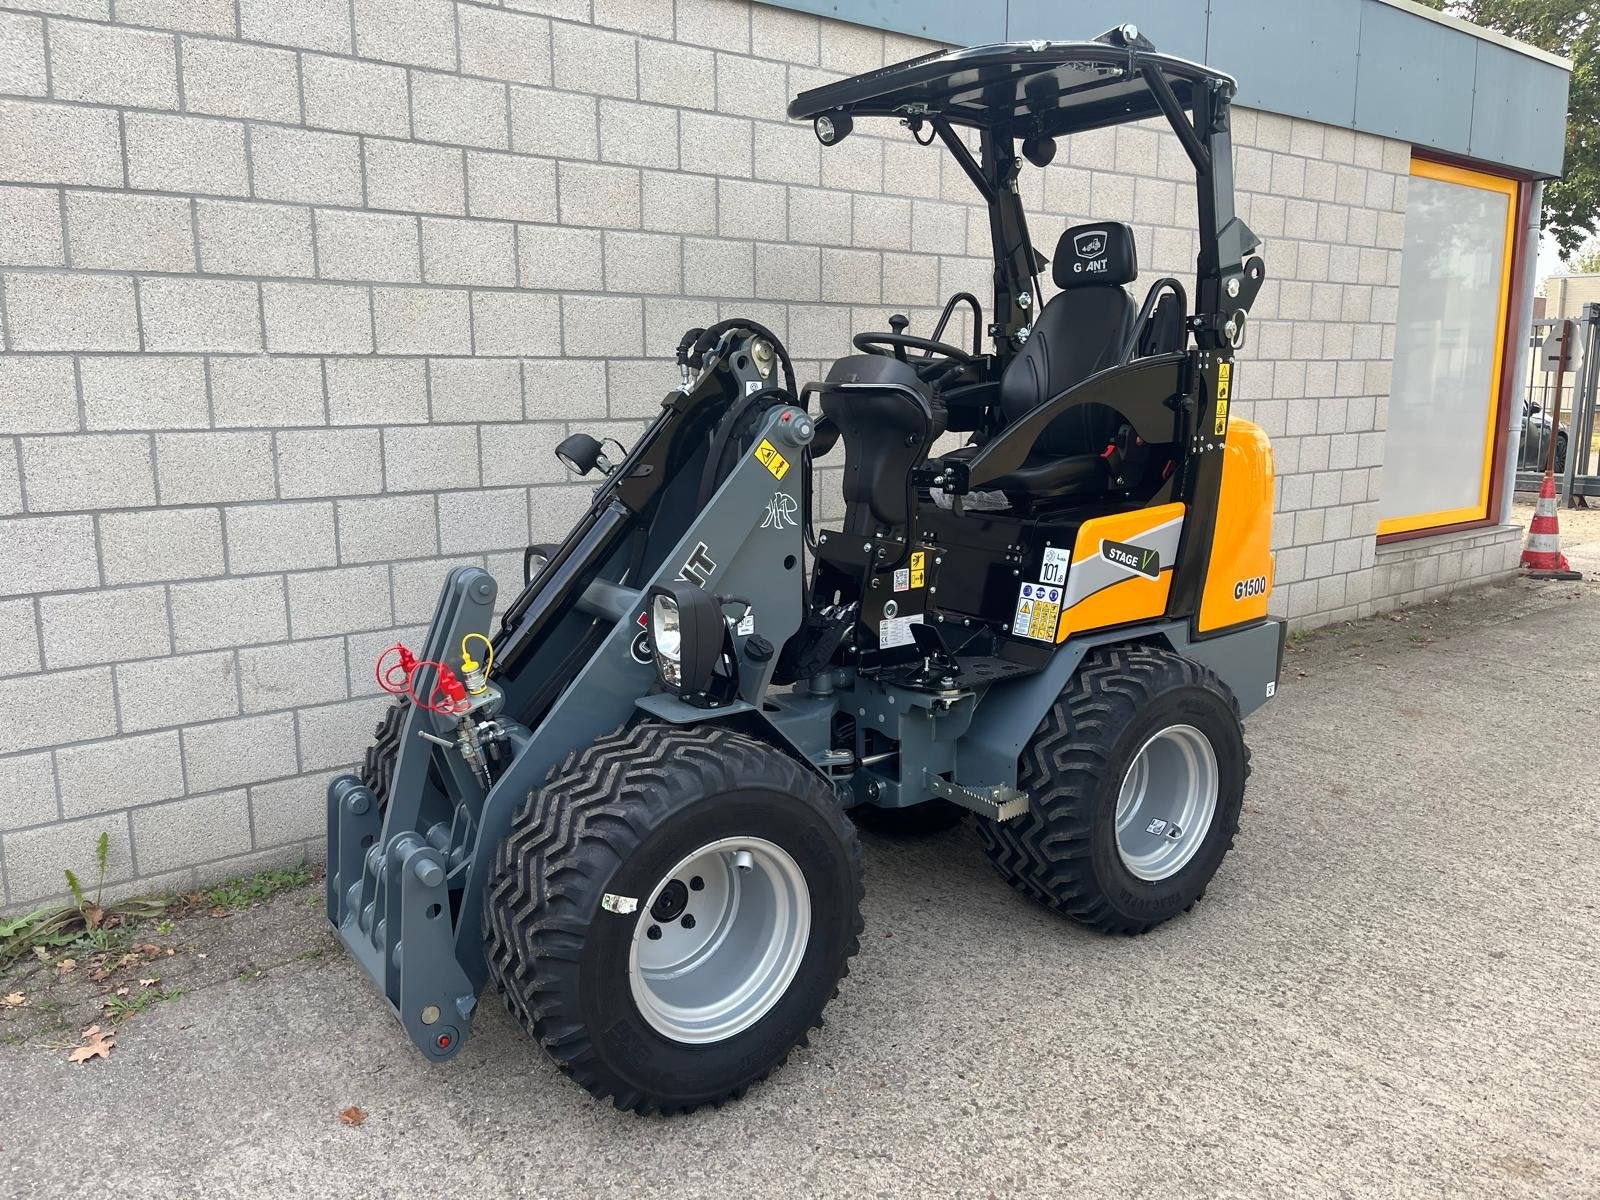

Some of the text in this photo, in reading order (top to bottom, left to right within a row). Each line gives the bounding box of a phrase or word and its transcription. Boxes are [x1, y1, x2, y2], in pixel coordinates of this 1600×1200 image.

[1108, 548, 1139, 567] STAGE
[1043, 562, 1059, 582] 101
[1234, 575, 1266, 600] G1500
